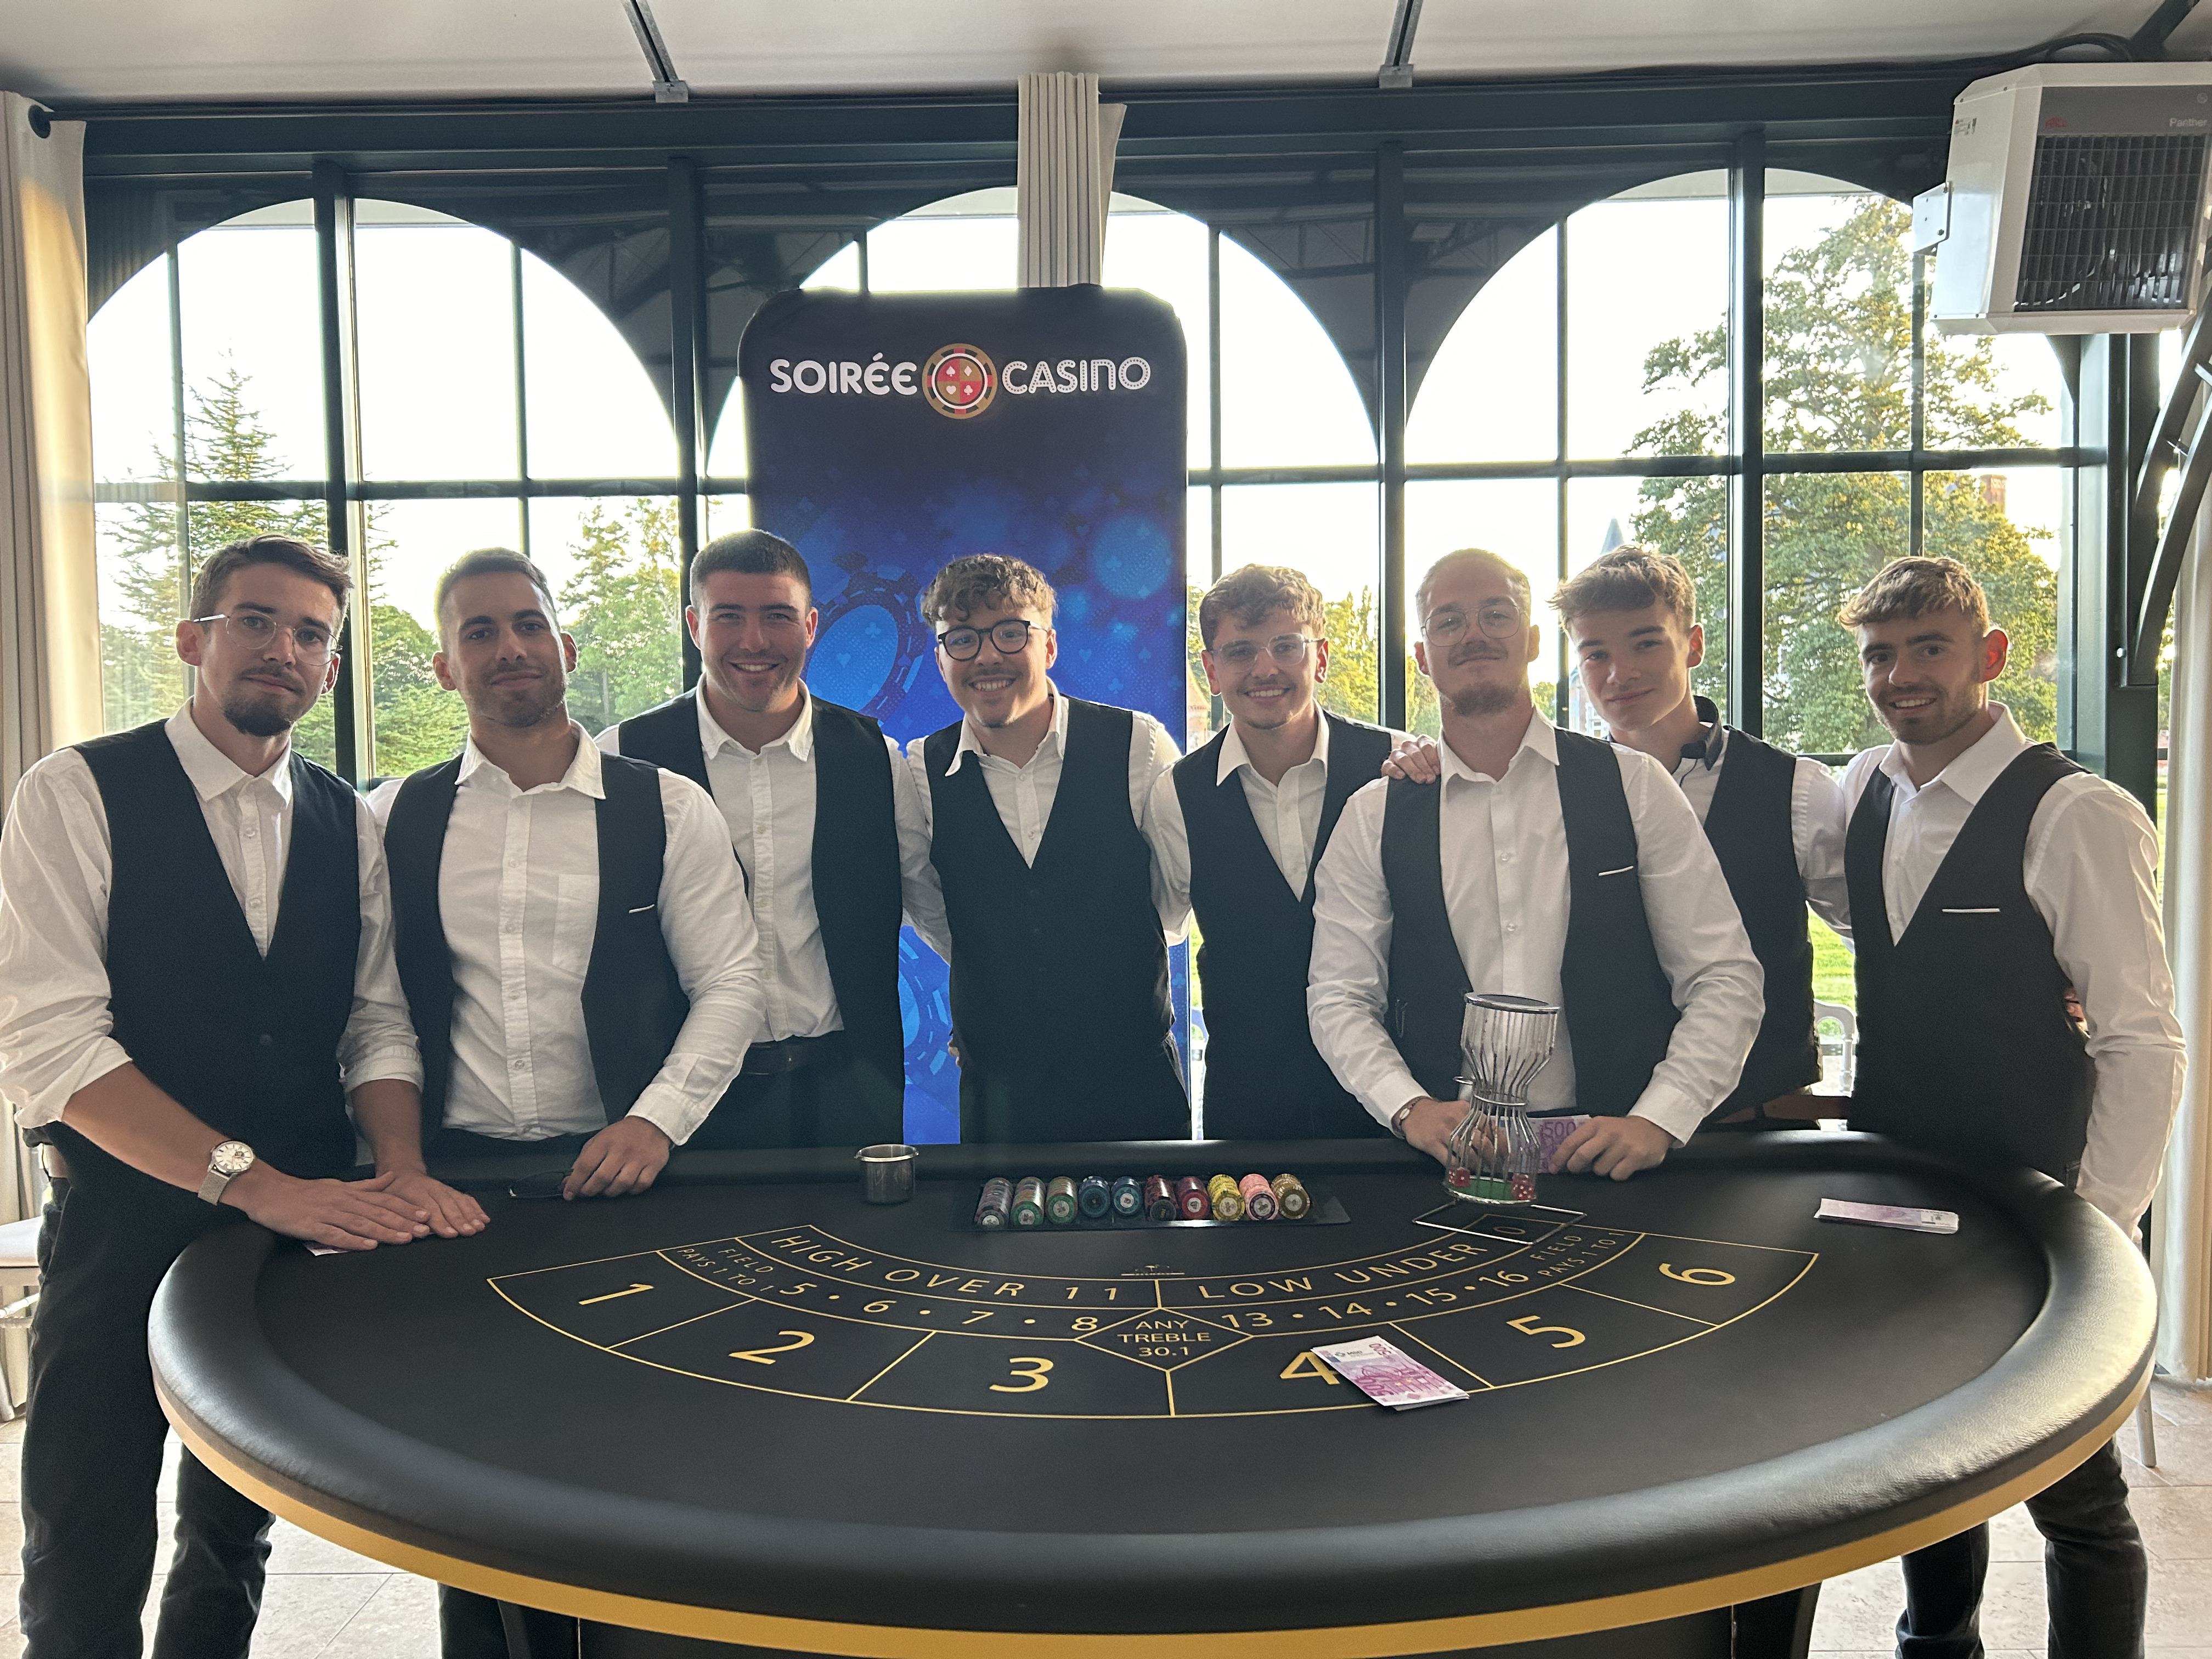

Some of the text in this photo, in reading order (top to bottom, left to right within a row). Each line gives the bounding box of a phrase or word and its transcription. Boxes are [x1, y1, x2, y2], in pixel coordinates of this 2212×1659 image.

[2169, 117, 2208, 127] Panther
[770, 352, 1152, 396] SOIRÉE CASINO
[1544, 1121, 1577, 1137] 500
[720, 1249, 774, 1272] FIELD
[1530, 1235, 1582, 1260] FIELD
[1537, 1258, 1585, 1277] PAYS
[1590, 1238, 1617, 1249] TO
[676, 1248, 716, 1267] PAYS
[728, 1273, 756, 1285] TO
[771, 1235, 1116, 1300] HIGH OVER 11
[1199, 1277, 1312, 1298] LOW
[1334, 1244, 1488, 1283] UNDER
[1658, 1263, 1735, 1285] 6
[578, 1283, 654, 1305] 1
[780, 1283, 1098, 1331] 5 6 7 8
[1222, 1271, 1528, 1328] 13 14 15 16
[1116, 1332, 1211, 1343] TREBLE
[1136, 1320, 1188, 1329] ANY
[1506, 1315, 1585, 1348] 5
[729, 1330, 815, 1364] 2
[989, 1357, 1054, 1392] 3
[1279, 1351, 1340, 1385] 4
